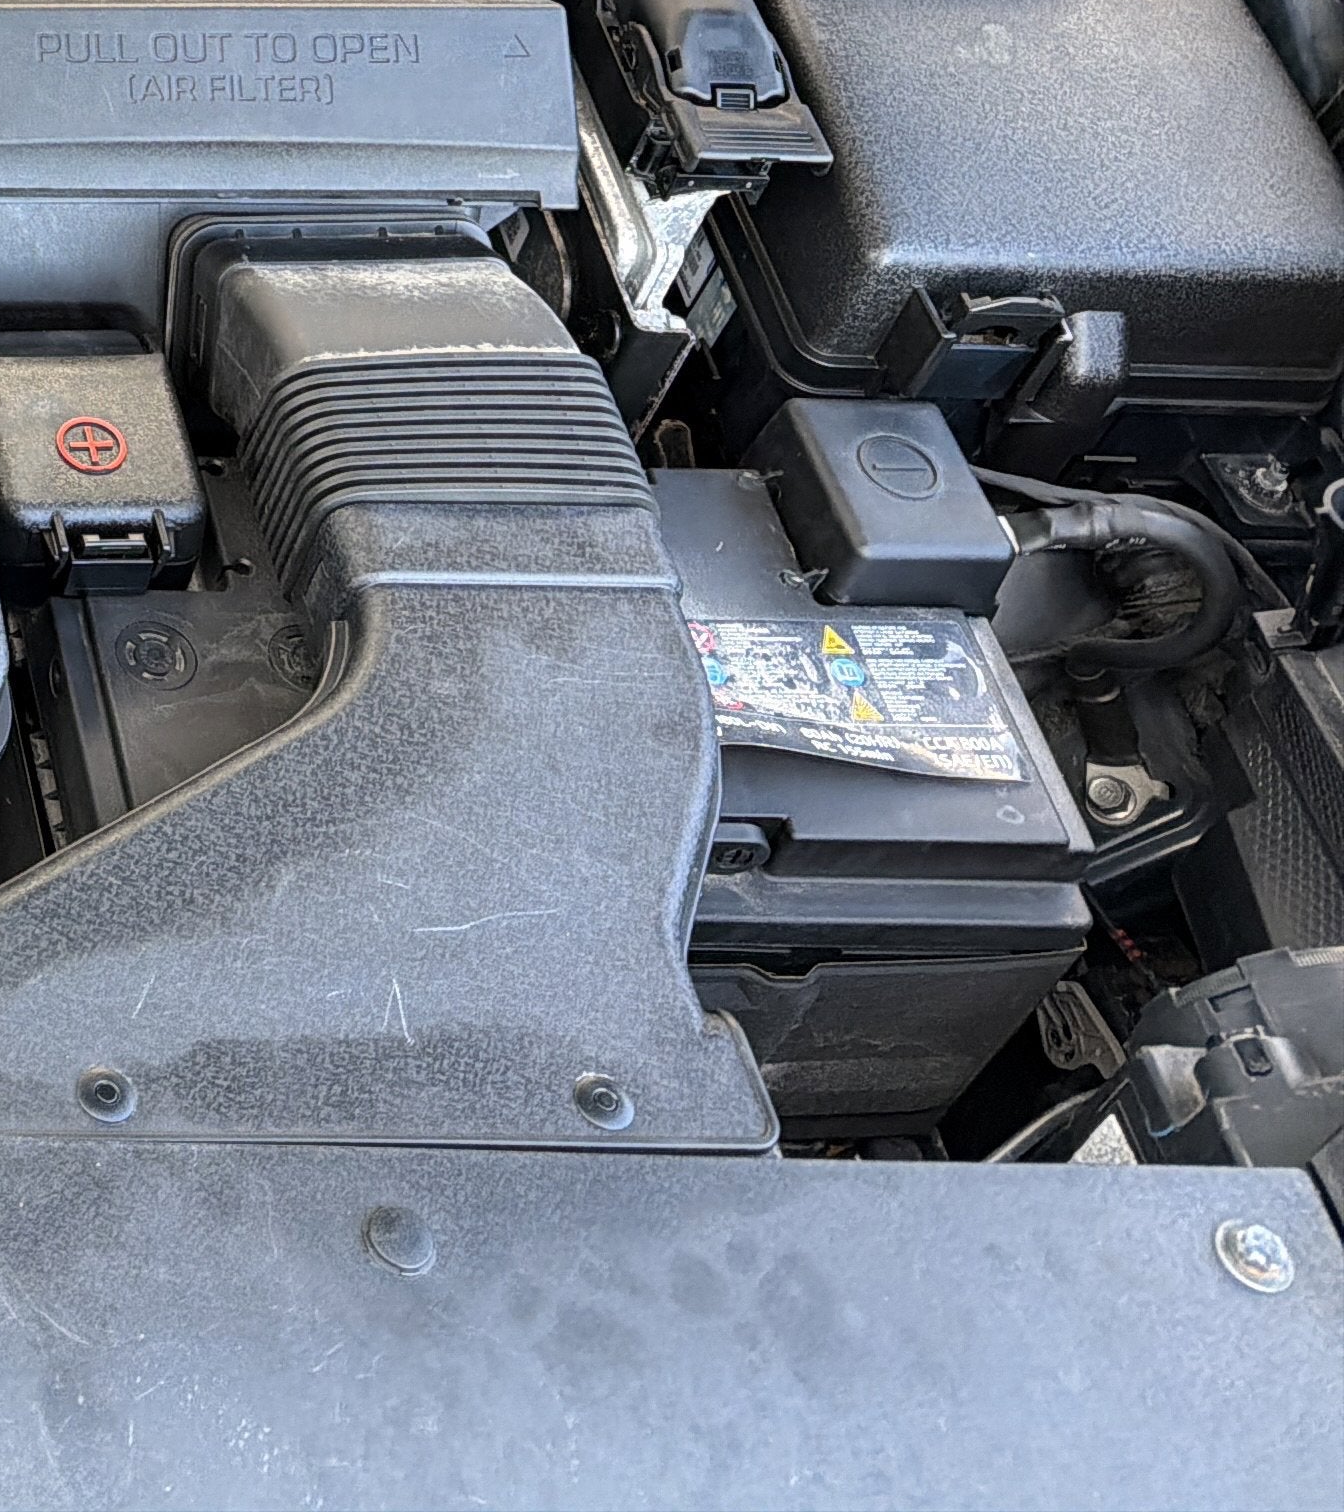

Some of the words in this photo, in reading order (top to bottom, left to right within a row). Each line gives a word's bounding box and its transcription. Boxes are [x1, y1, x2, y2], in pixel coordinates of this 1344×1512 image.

[35, 31, 139, 64] PULL
[151, 31, 233, 64] OUT
[244, 32, 299, 64] TO
[313, 32, 421, 65] OPEN
[128, 73, 197, 104] (AIR
[209, 74, 335, 105] FILTER)
[960, 736, 1005, 752] 800A
